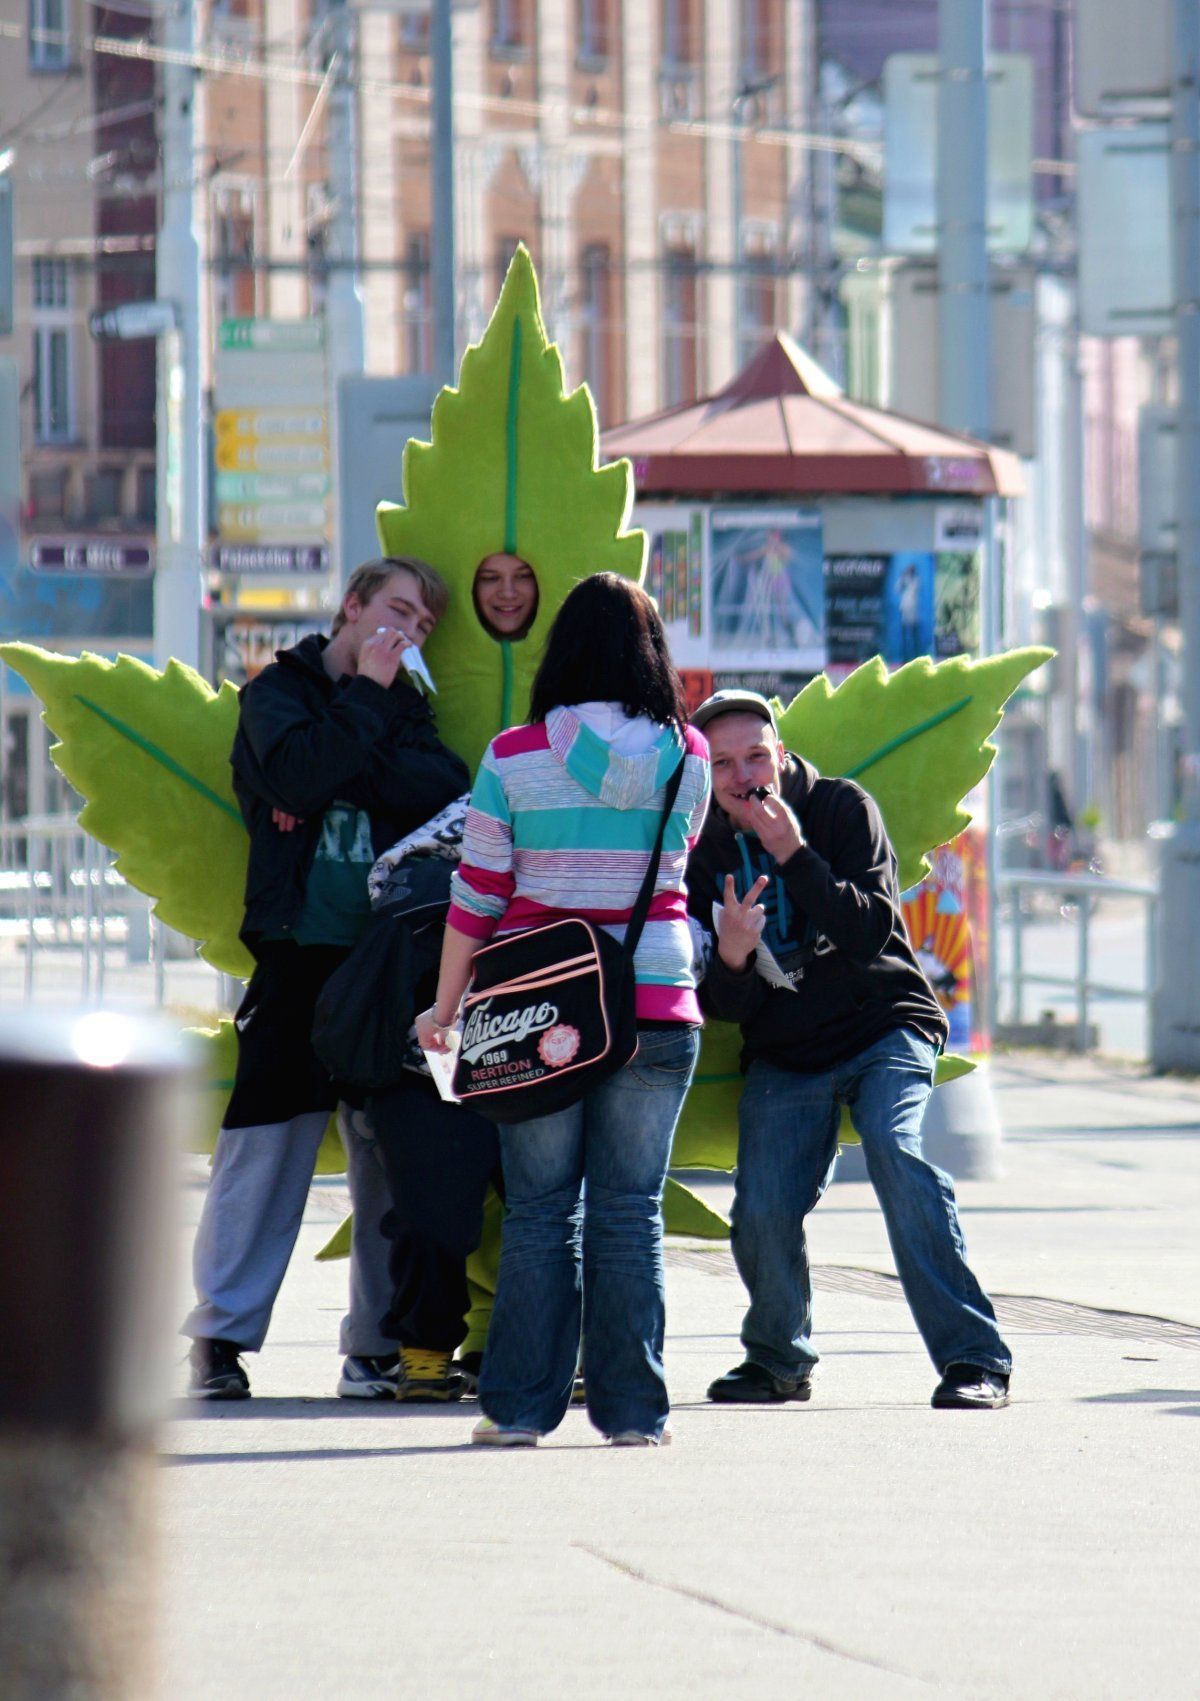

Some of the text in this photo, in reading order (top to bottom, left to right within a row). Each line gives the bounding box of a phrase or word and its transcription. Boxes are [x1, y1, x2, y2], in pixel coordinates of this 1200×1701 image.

[462, 997, 558, 1057] Chicago
[481, 1050, 508, 1066] 1969
[467, 1068, 545, 1091] SUPER REFINED
[471, 1059, 532, 1081] RERTION
